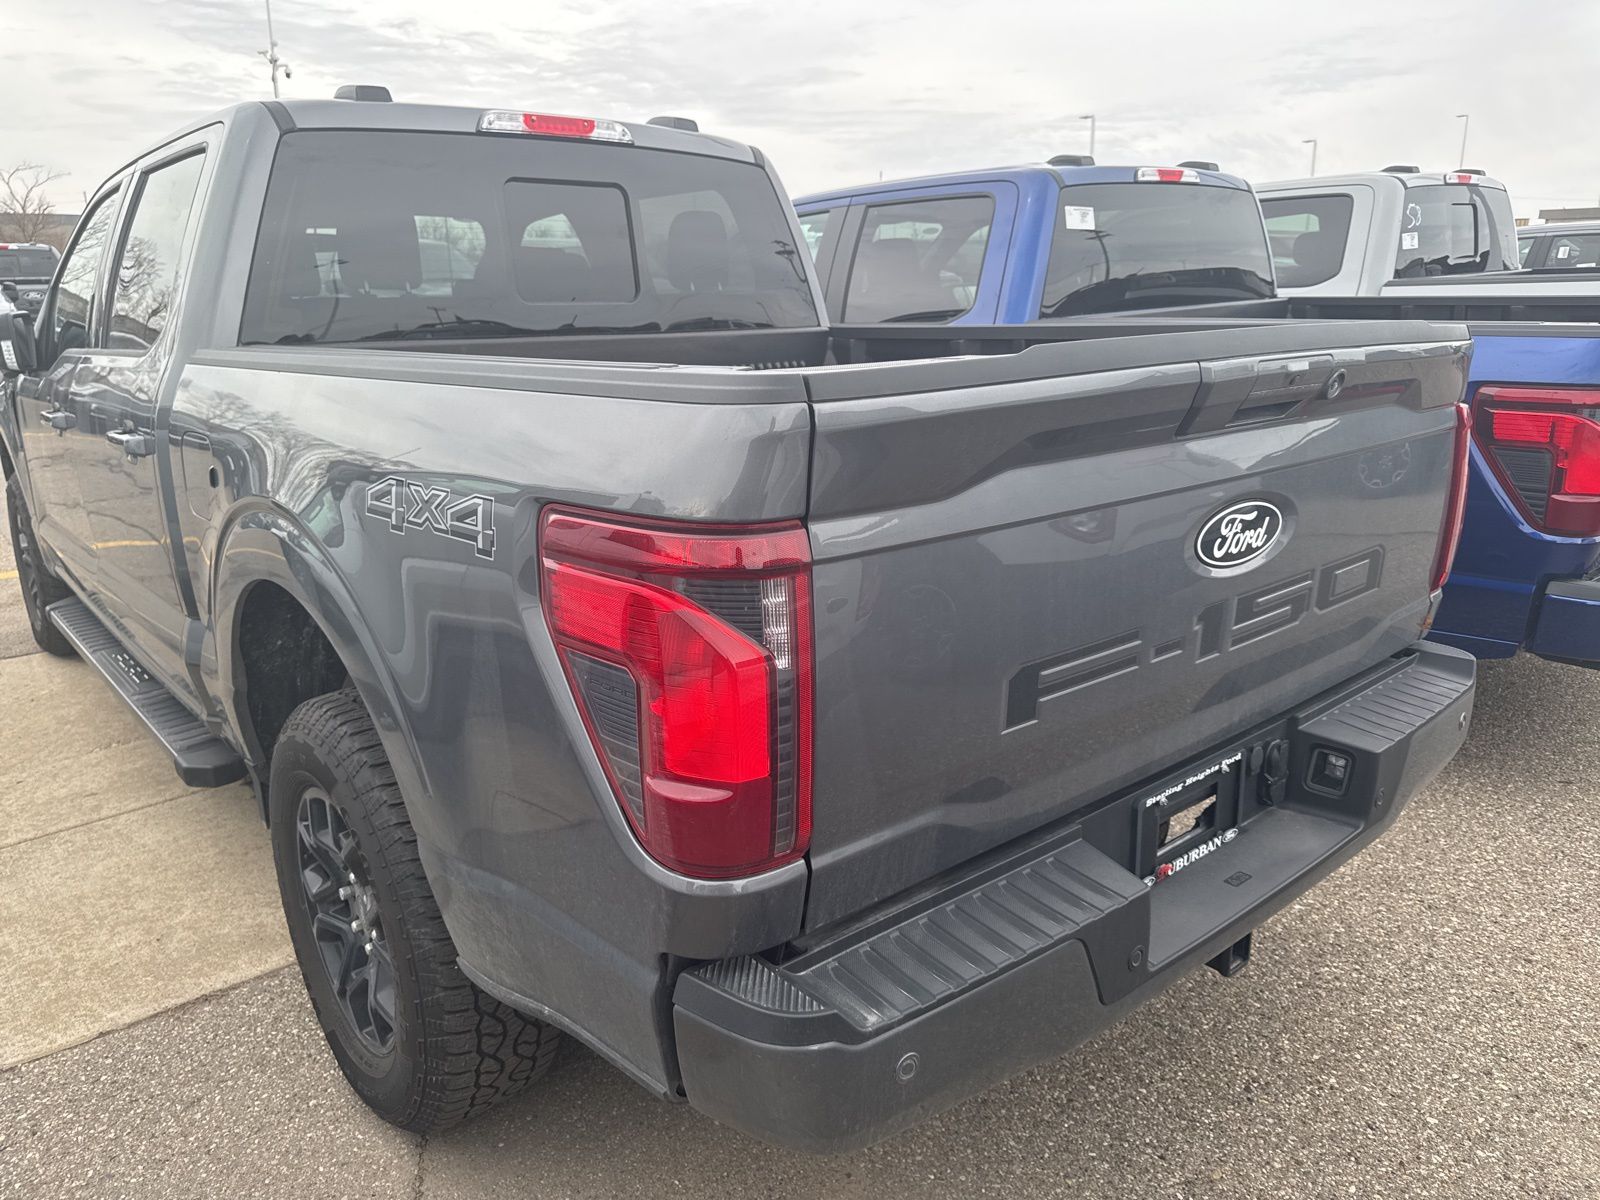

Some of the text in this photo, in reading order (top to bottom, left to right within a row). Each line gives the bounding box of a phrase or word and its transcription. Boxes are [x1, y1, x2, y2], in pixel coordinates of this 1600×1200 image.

[1213, 511, 1267, 560] Ford
[1001, 544, 1383, 735] F-150
[1146, 752, 1242, 807] Sterling Heights Ford
